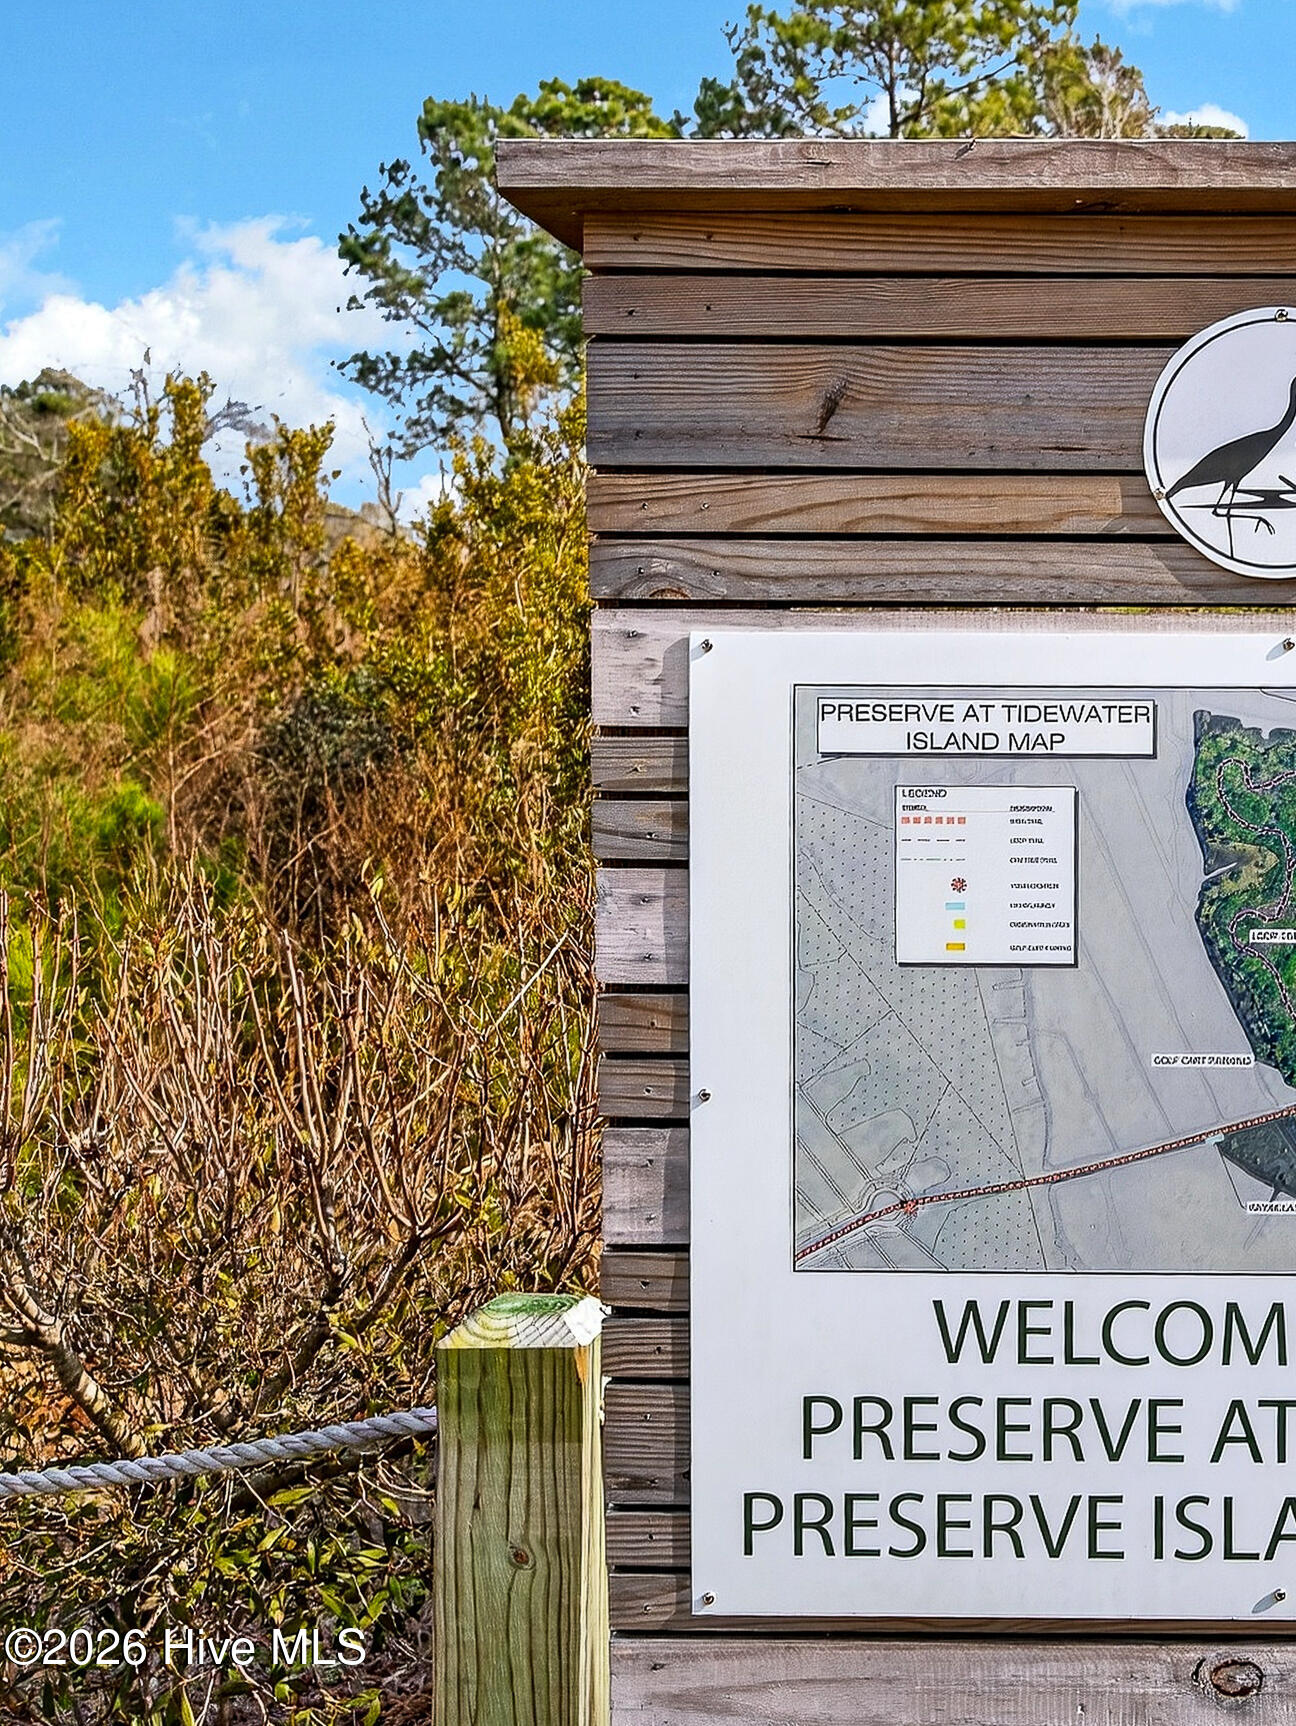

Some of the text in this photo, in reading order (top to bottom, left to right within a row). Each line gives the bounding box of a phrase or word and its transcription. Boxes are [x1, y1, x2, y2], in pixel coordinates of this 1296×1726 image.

[821, 703, 1151, 724] PRESERVE AT TIDEWATER
[906, 731, 1066, 752] ISLAND MAP
[802, 1395, 1185, 1464] PRESERVE
[743, 1491, 1125, 1560] PRESERVE
